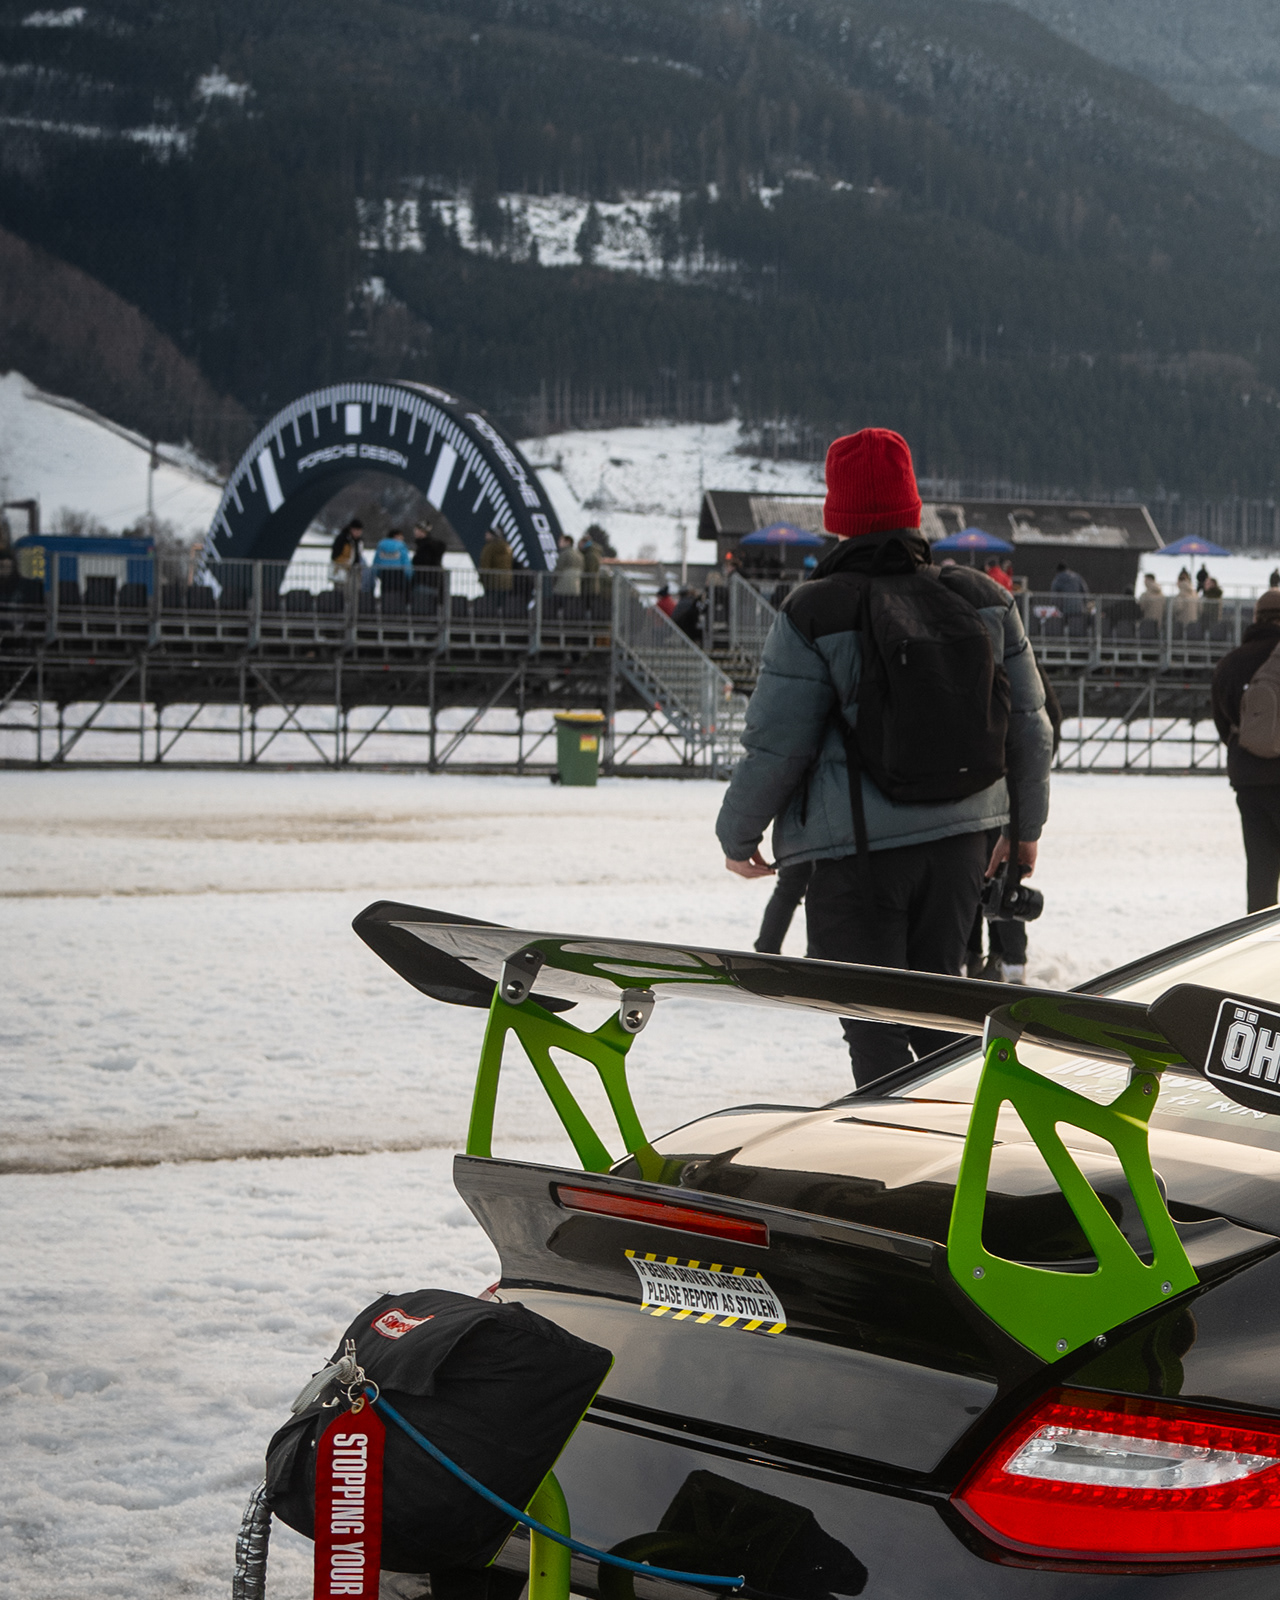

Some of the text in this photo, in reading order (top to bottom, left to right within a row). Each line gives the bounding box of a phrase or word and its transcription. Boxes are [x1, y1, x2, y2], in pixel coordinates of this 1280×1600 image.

[297, 443, 409, 472] PORSCHE DESIGN
[465, 412, 541, 508] PORSCHE
[632, 1259, 774, 1299] IF BEING DRIVEN CAREFULLY,
[646, 1281, 780, 1319] PLEASE REPORT AS STOLEN!
[331, 1433, 368, 1535] STOPPING
[330, 1541, 366, 1597] YOUR
